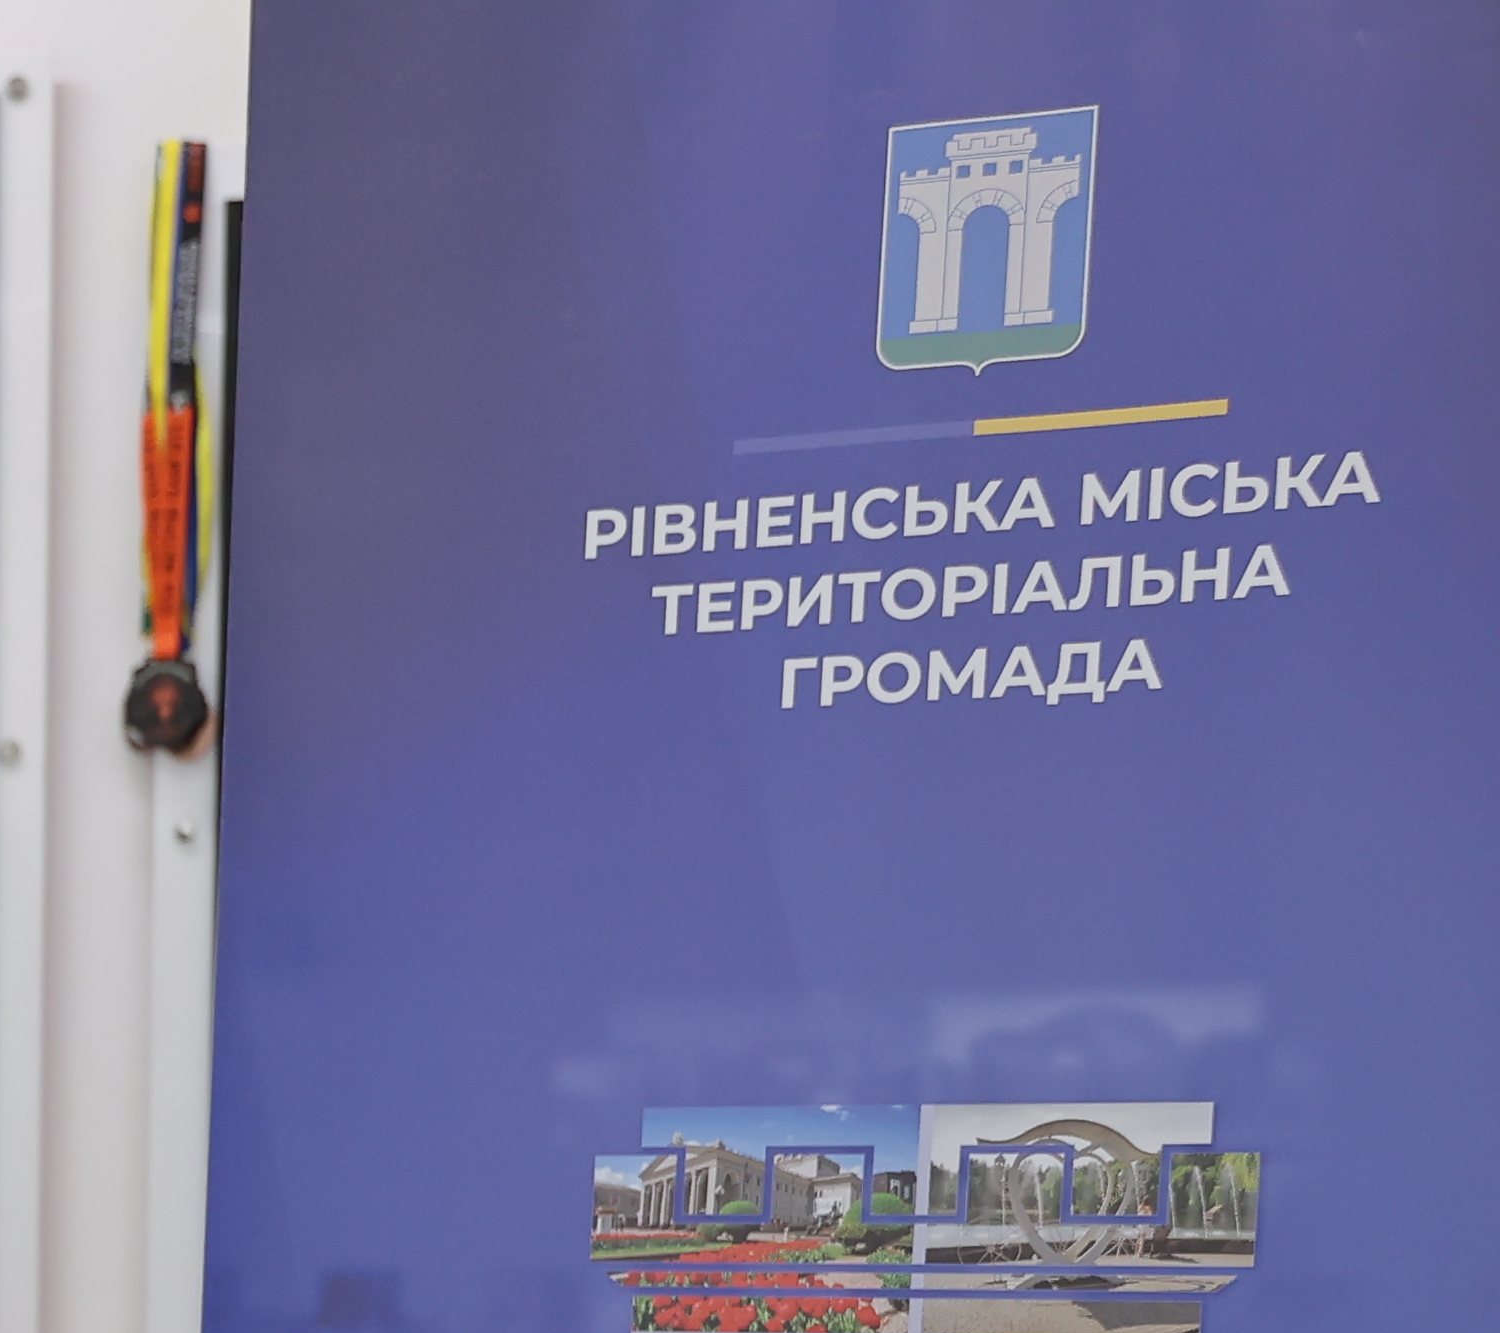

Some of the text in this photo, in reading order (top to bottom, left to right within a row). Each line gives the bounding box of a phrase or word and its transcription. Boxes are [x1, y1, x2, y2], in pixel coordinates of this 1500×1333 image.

[584, 451, 1381, 560] РІВНЕНСЬКА МІСЬКА
[650, 544, 1291, 635] ТЕРИТОРІАЛЬНА
[780, 638, 1163, 709] ГРОМАДА
